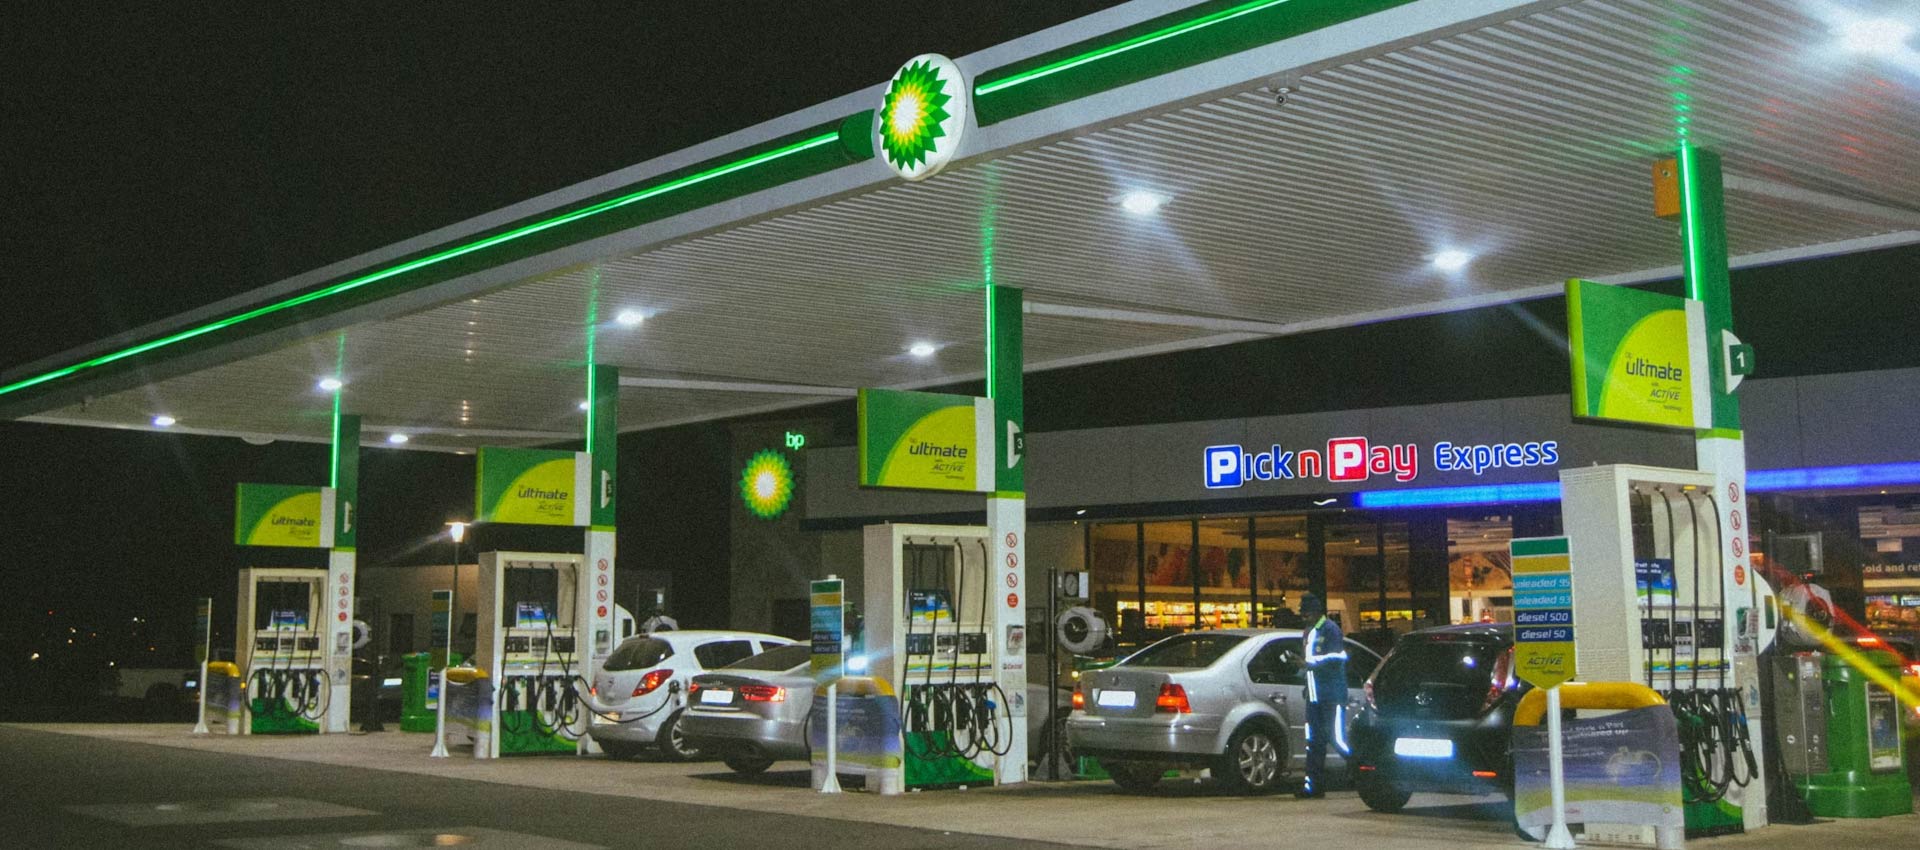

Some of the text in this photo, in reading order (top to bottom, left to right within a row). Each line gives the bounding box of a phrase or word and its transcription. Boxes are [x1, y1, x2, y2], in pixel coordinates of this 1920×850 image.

[1736, 352, 1745, 368] 1
[1626, 357, 1682, 381] ultimate
[1650, 389, 1680, 400] ACTIVE
[785, 431, 804, 450] bp
[1016, 438, 1023, 449] 3
[909, 441, 968, 458] ultimate
[1205, 437, 1559, 488] Pick n Pay Express
[518, 487, 568, 500] ultimate
[1885, 563, 1904, 572] and
[1513, 578, 1557, 589] unleaded
[1514, 595, 1557, 606] unleaded
[1517, 612, 1569, 623] diesel 500
[1521, 629, 1566, 640] diesel 50
[1527, 656, 1563, 665] ACTIVE
